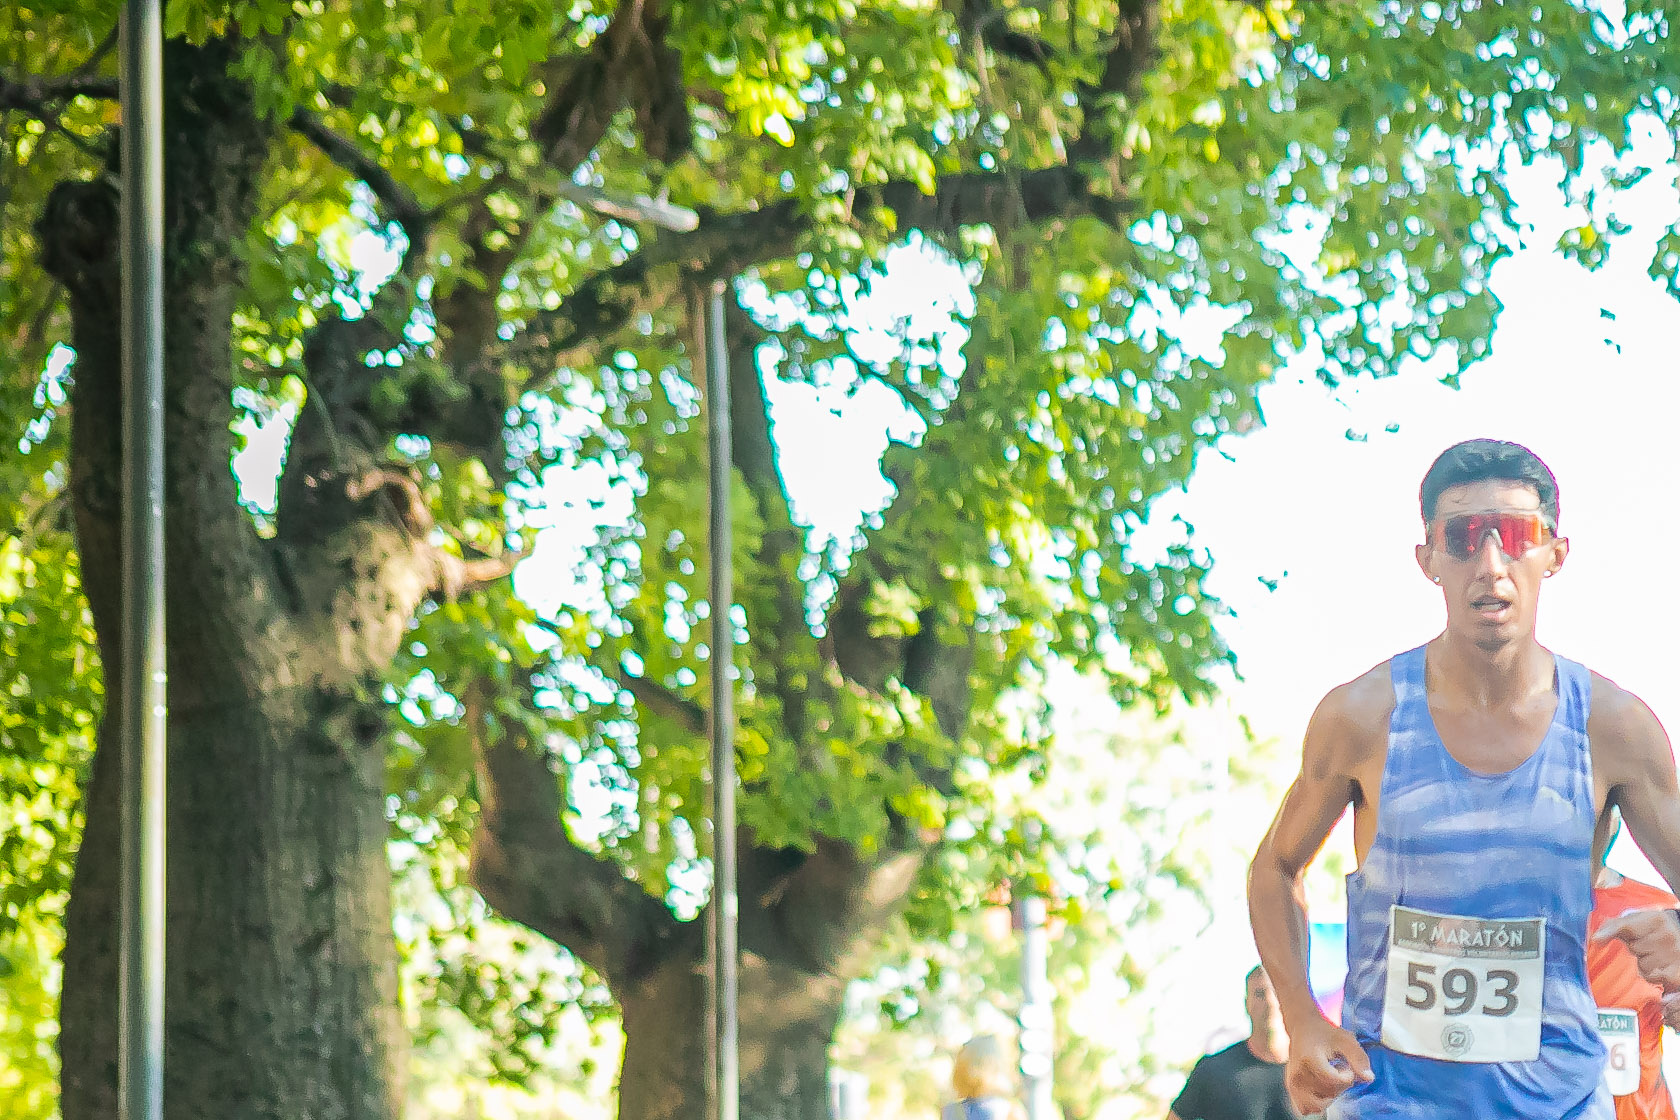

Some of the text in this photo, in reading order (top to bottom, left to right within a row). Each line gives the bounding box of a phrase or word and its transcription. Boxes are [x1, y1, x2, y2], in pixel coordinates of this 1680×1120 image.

[1430, 924, 1523, 947] MARATÓN
[1405, 961, 1520, 1018] 593
[1599, 1015, 1629, 1030] ATÓN
